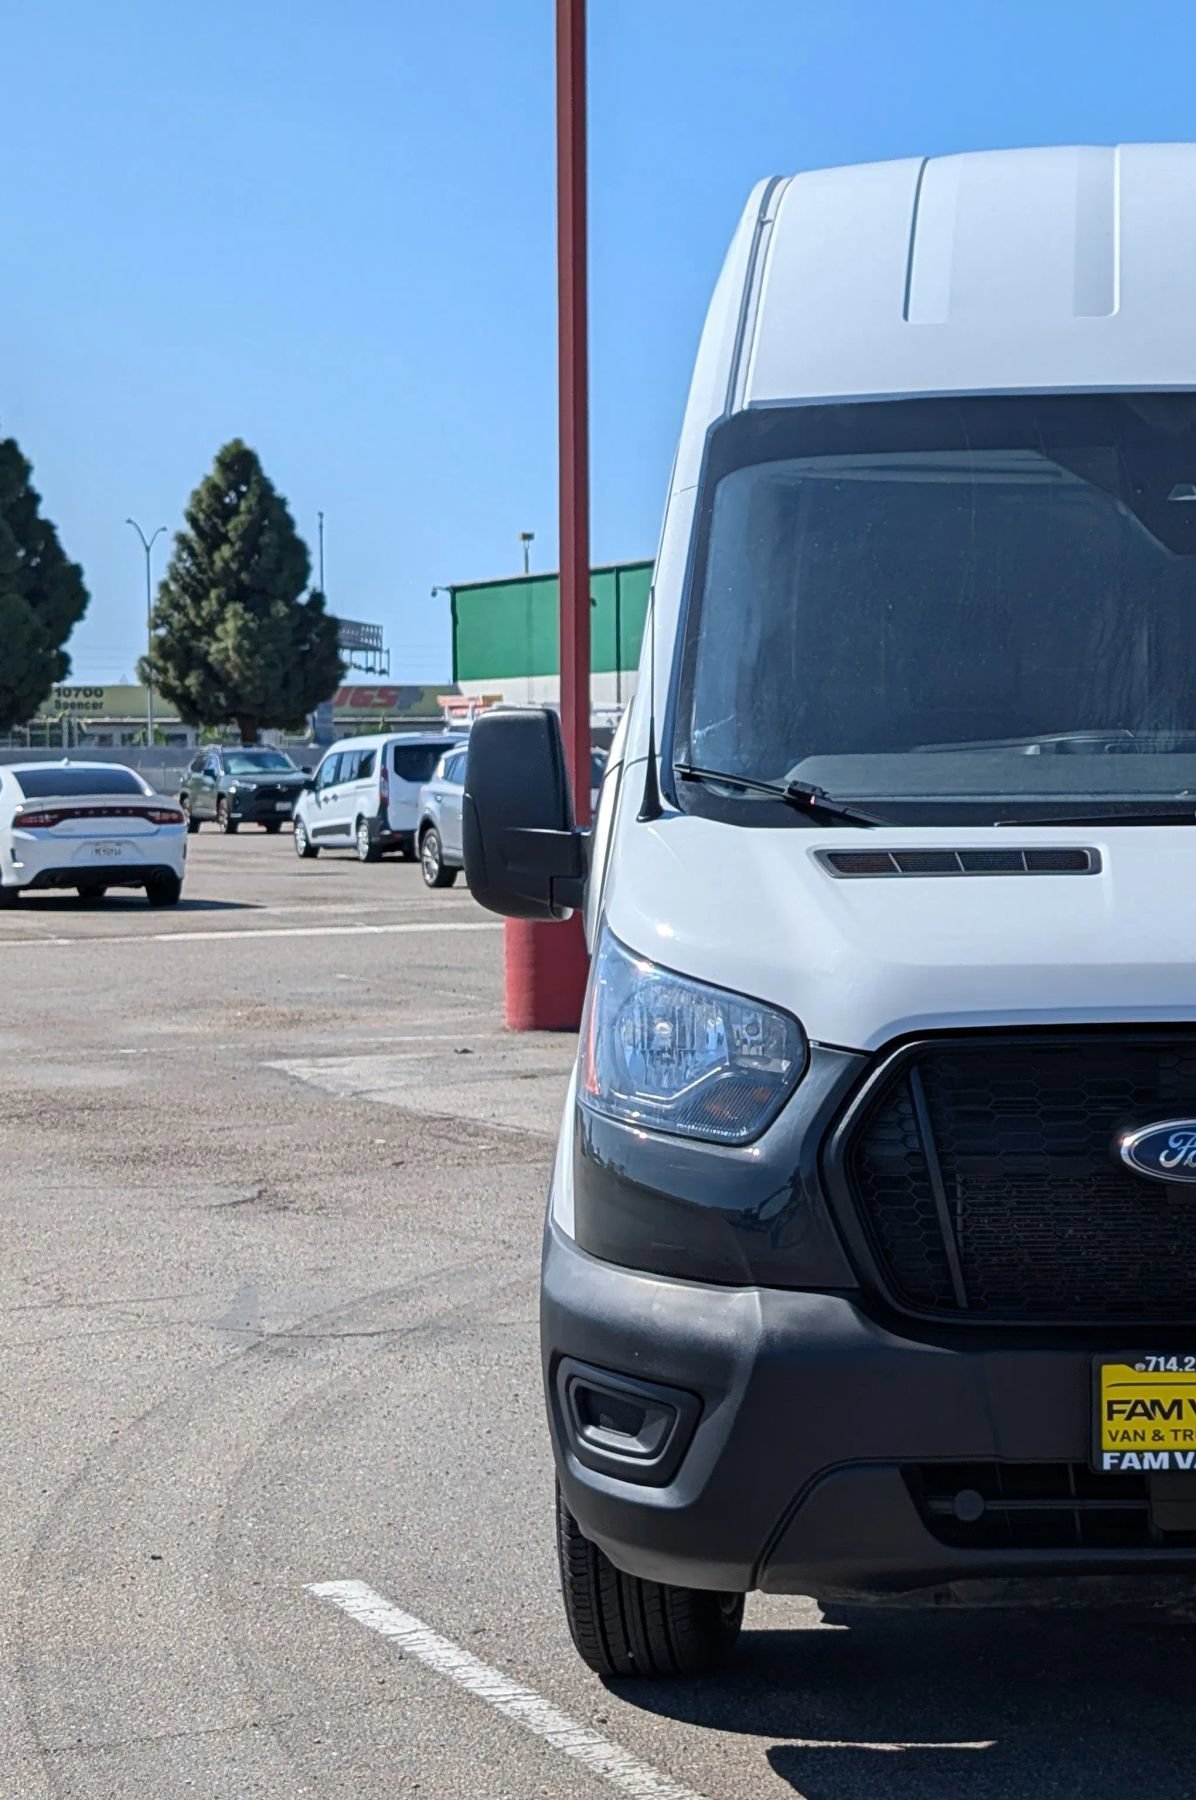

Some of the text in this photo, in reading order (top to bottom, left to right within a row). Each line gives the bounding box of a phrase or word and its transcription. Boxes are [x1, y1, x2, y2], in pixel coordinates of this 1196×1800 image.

[54, 687, 103, 698] 10700
[54, 701, 104, 710] Spencer
[1106, 1399, 1184, 1421] FAM
[1108, 1429, 1146, 1442] VAN
[1151, 1429, 1165, 1442] &
